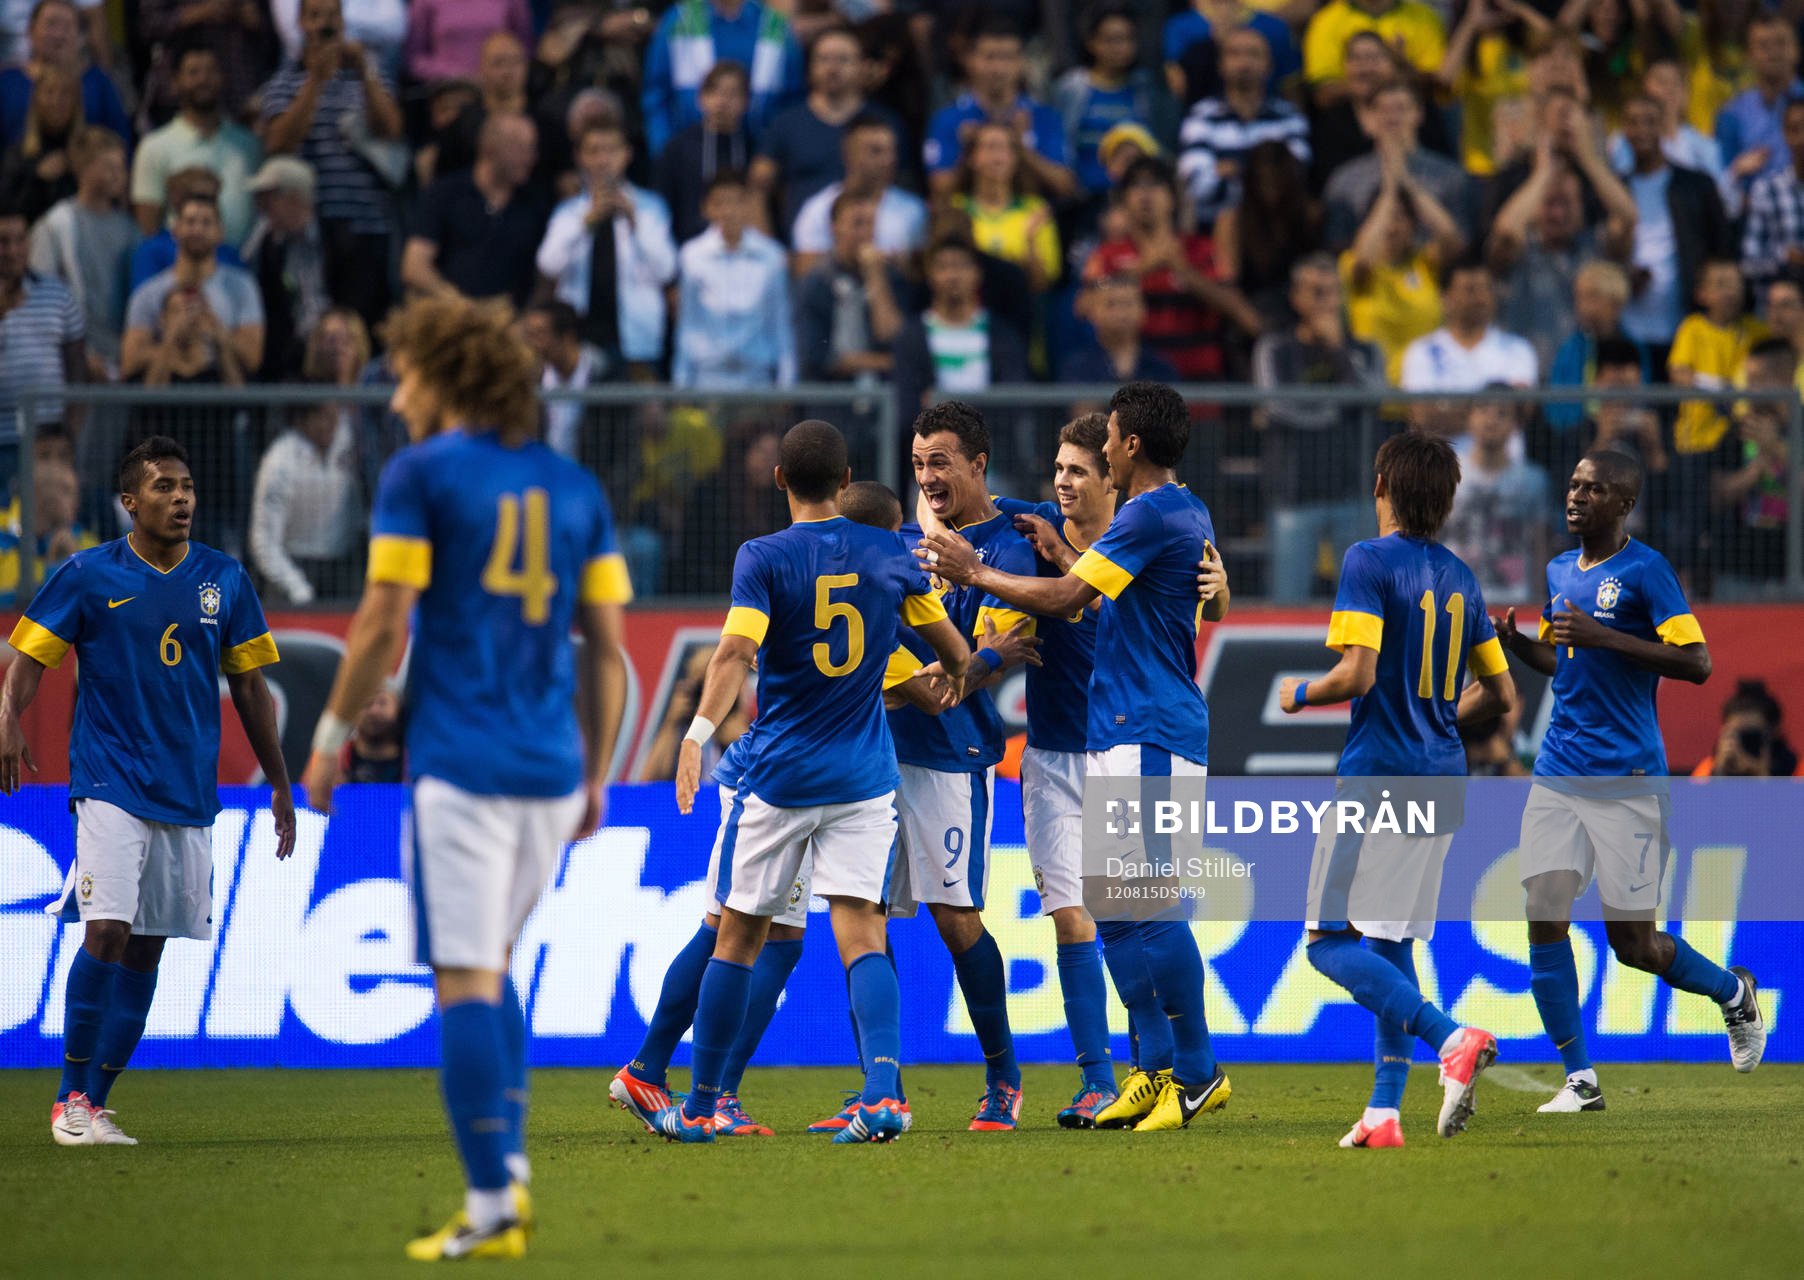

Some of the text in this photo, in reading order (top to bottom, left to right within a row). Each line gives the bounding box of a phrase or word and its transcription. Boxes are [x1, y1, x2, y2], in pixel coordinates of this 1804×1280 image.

[480, 487, 558, 627] 4
[160, 623, 182, 666] 6
[813, 572, 864, 678] 5
[1418, 589, 1464, 701] 11
[944, 826, 964, 869] 9
[1634, 832, 1654, 874] 7
